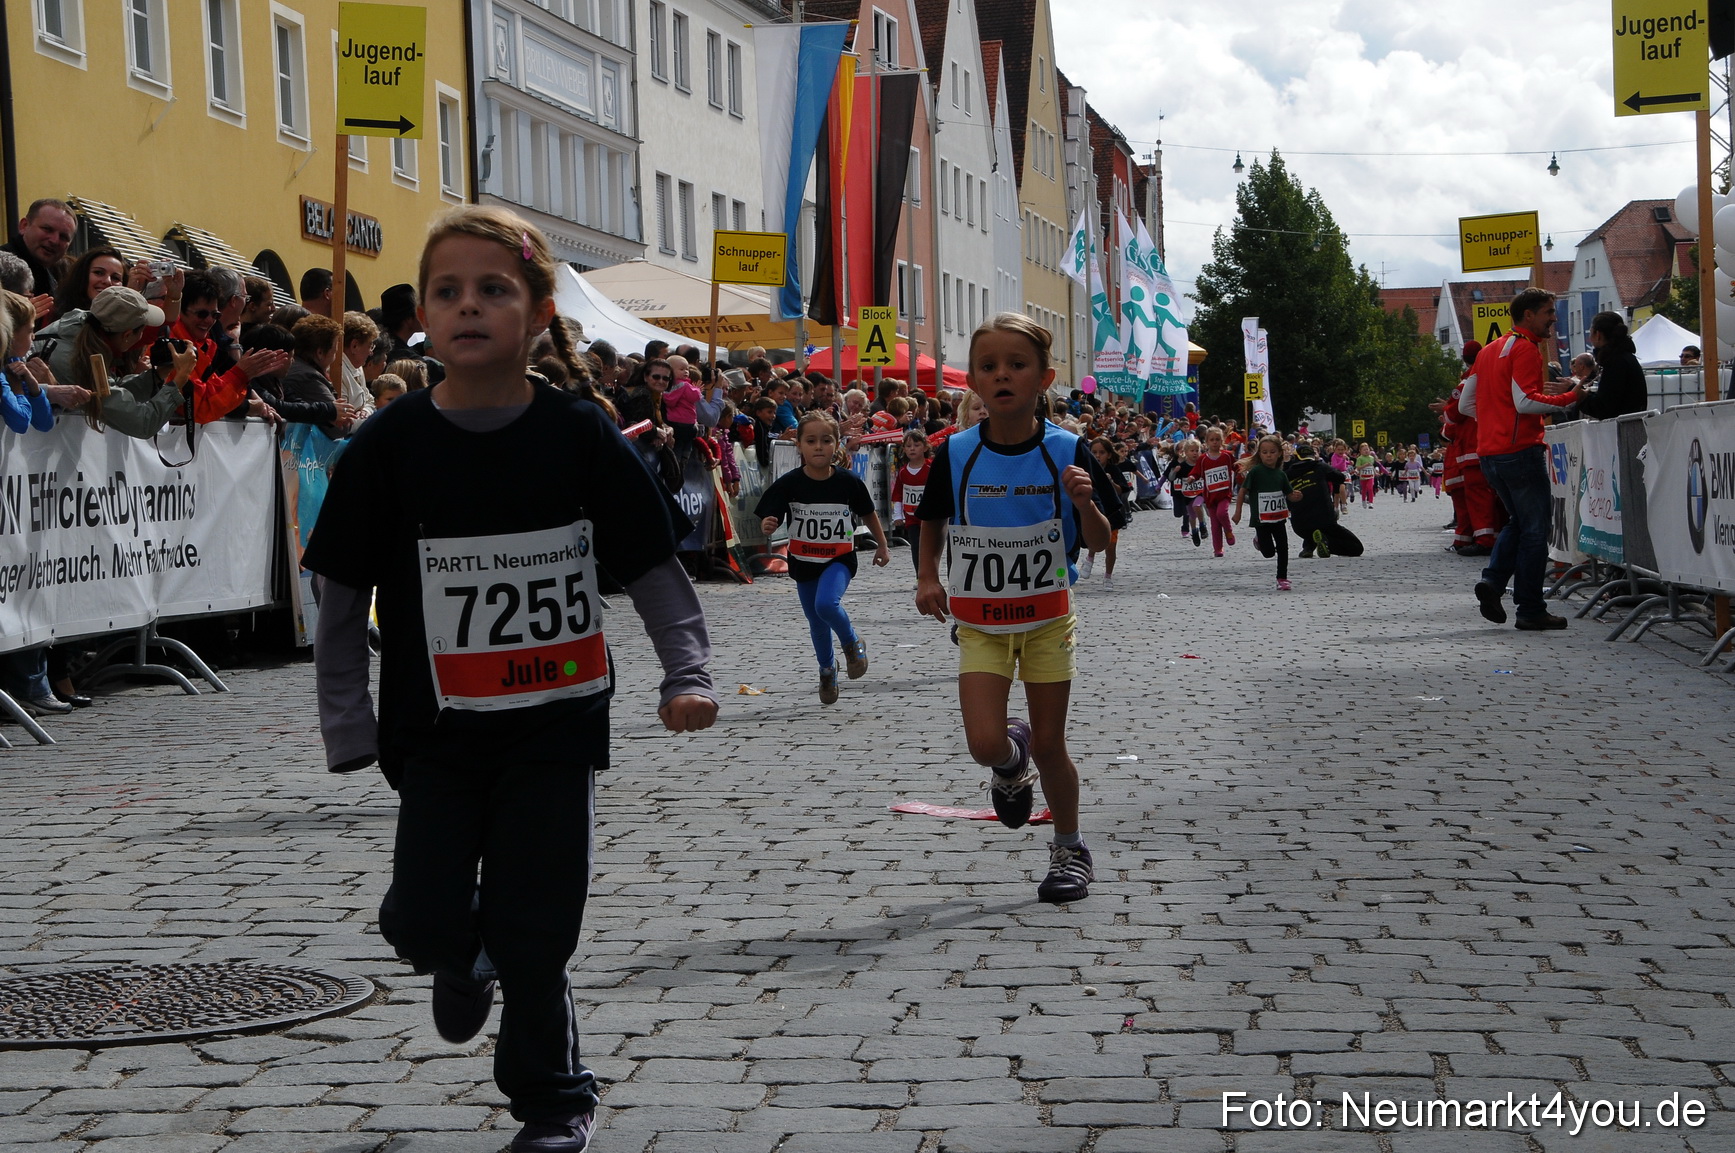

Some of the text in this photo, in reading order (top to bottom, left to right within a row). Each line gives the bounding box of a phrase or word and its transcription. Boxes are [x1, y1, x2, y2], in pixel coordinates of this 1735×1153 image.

[1615, 9, 1705, 39] Jugend-
[341, 38, 423, 65] Jugend-
[1641, 37, 1682, 61] lauf
[364, 64, 402, 86] lauf
[347, 213, 383, 252] CANTO
[1464, 229, 1533, 244] Schnupper-
[718, 245, 781, 260] Schnupper-
[1489, 244, 1511, 257] lauf
[738, 261, 759, 272] lauf
[862, 309, 892, 320] Block
[1477, 305, 1511, 318] Block
[865, 324, 887, 353] A
[1485, 321, 1503, 347] A
[1249, 381, 1259, 394] B
[1355, 425, 1362, 434] C
[1379, 435, 1386, 443] D
[1208, 471, 1228, 484] 7043
[28, 470, 196, 537] EfficientDynamics
[794, 517, 846, 541] 7054
[801, 544, 837, 556] Simone
[953, 534, 1045, 549] PARTL Neumarkt
[28, 544, 106, 590] Verbrauch.
[426, 544, 579, 573] PARTL Neumarkt
[961, 549, 1054, 593] 7042
[444, 571, 591, 648] 7255
[982, 603, 1035, 621] Felina
[501, 657, 558, 688] Jule
